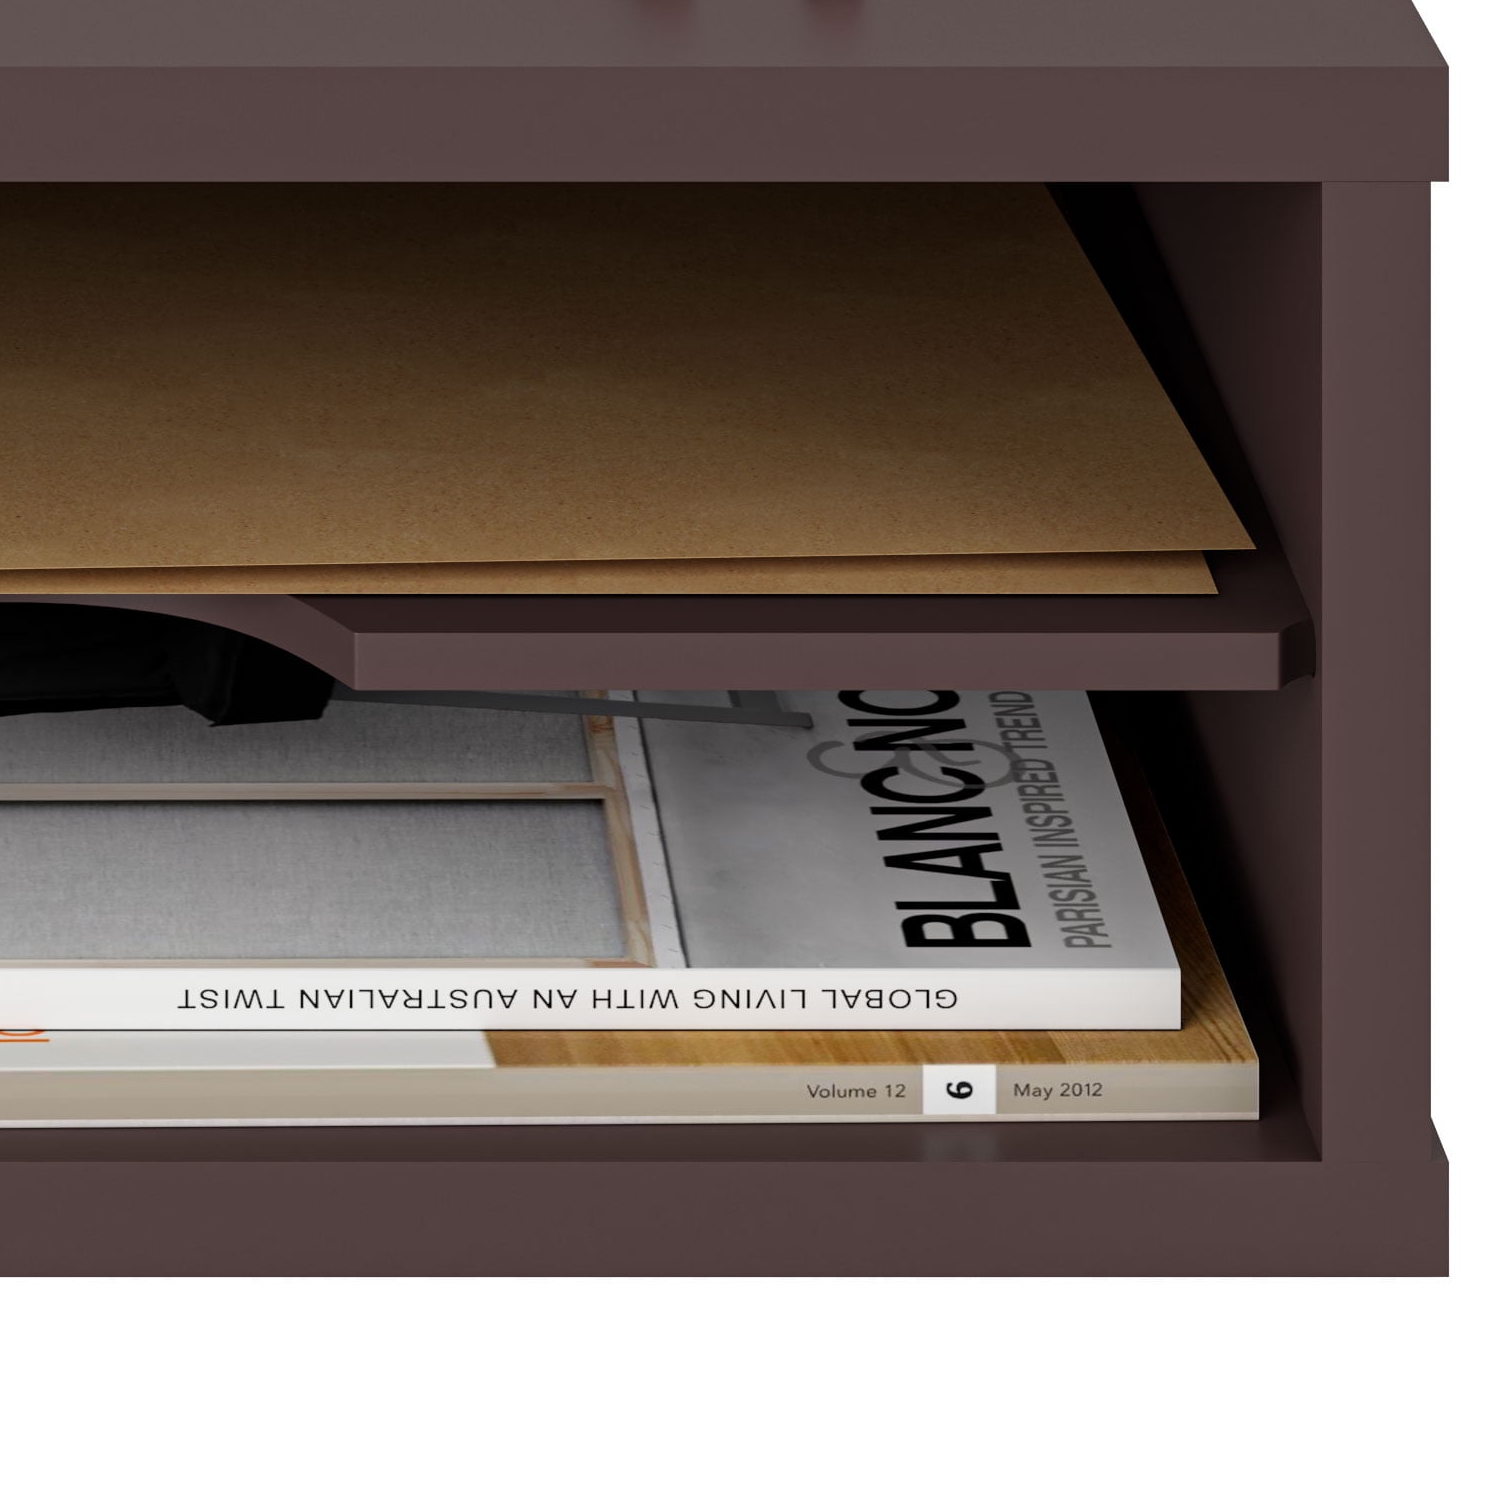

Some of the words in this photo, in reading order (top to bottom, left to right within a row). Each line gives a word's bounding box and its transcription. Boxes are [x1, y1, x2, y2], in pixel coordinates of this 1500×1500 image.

[1009, 758, 1080, 847] INSPIRED
[859, 765, 1032, 948] BLANC
[1037, 855, 1113, 948] PARISIAN
[176, 988, 286, 1010] TWIST
[299, 988, 519, 1010] AUSTRALIAN
[533, 988, 579, 1010] AN
[592, 988, 680, 1010] WITH
[693, 988, 807, 1010] LIVING
[821, 988, 959, 1010] GLOBAL
[806, 1084, 878, 1100] Volume
[885, 1084, 907, 1099] 12
[1013, 1083, 1054, 1101] May
[1059, 1082, 1103, 1098] 2012
